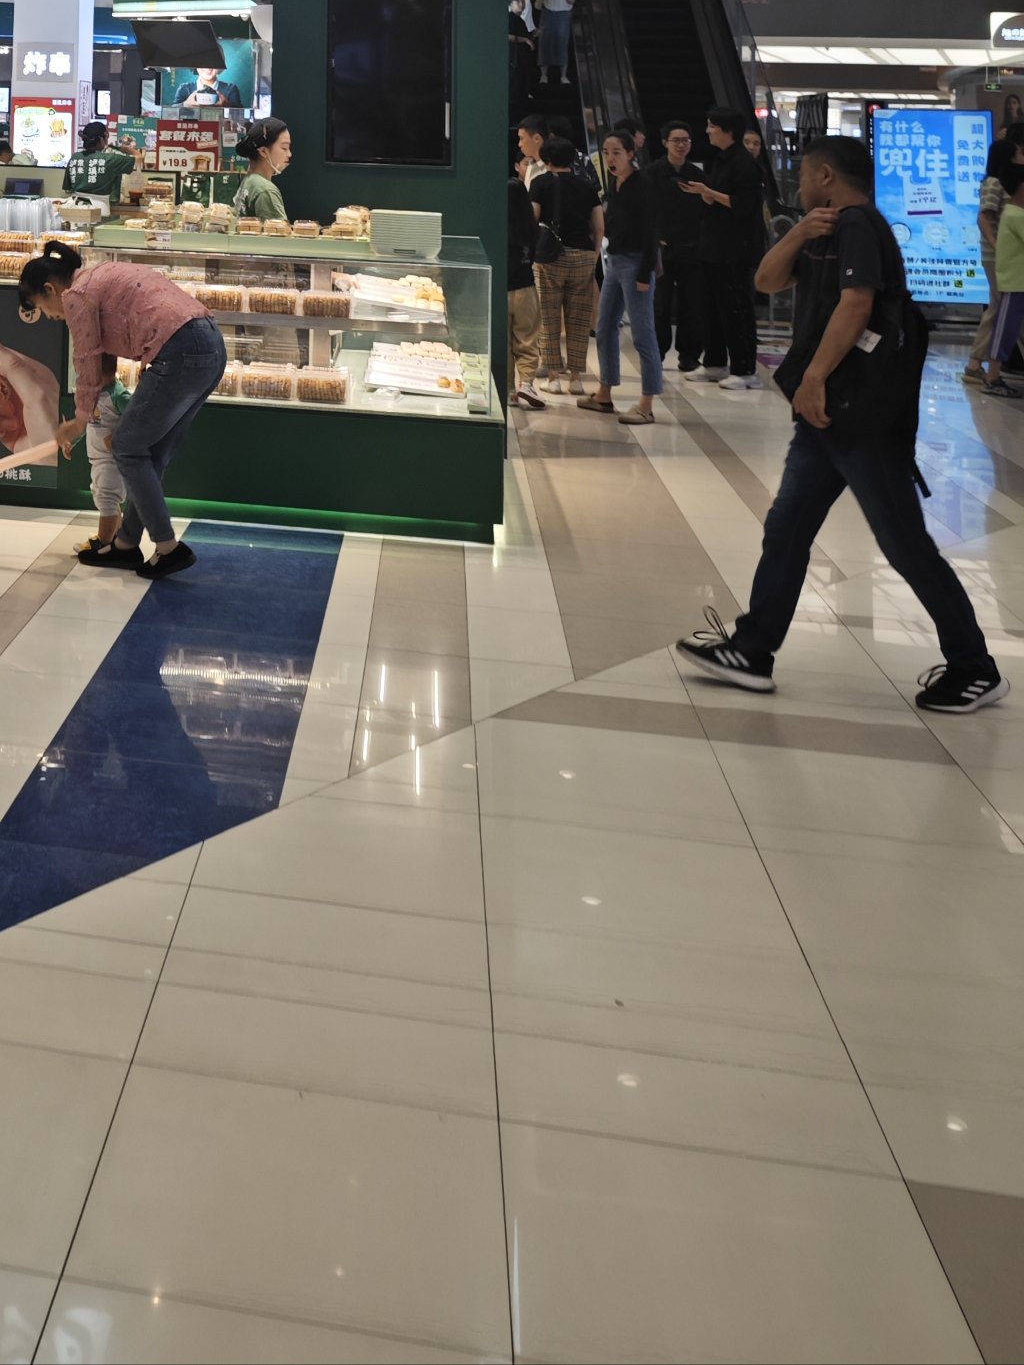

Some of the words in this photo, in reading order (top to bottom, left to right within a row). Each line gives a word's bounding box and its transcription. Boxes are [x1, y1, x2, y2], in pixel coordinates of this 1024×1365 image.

[879, 120, 925, 134] 有什么
[879, 134, 942, 147] 我都帮你
[162, 158, 188, 168] ¥19.8
[879, 147, 951, 178] 兜住
